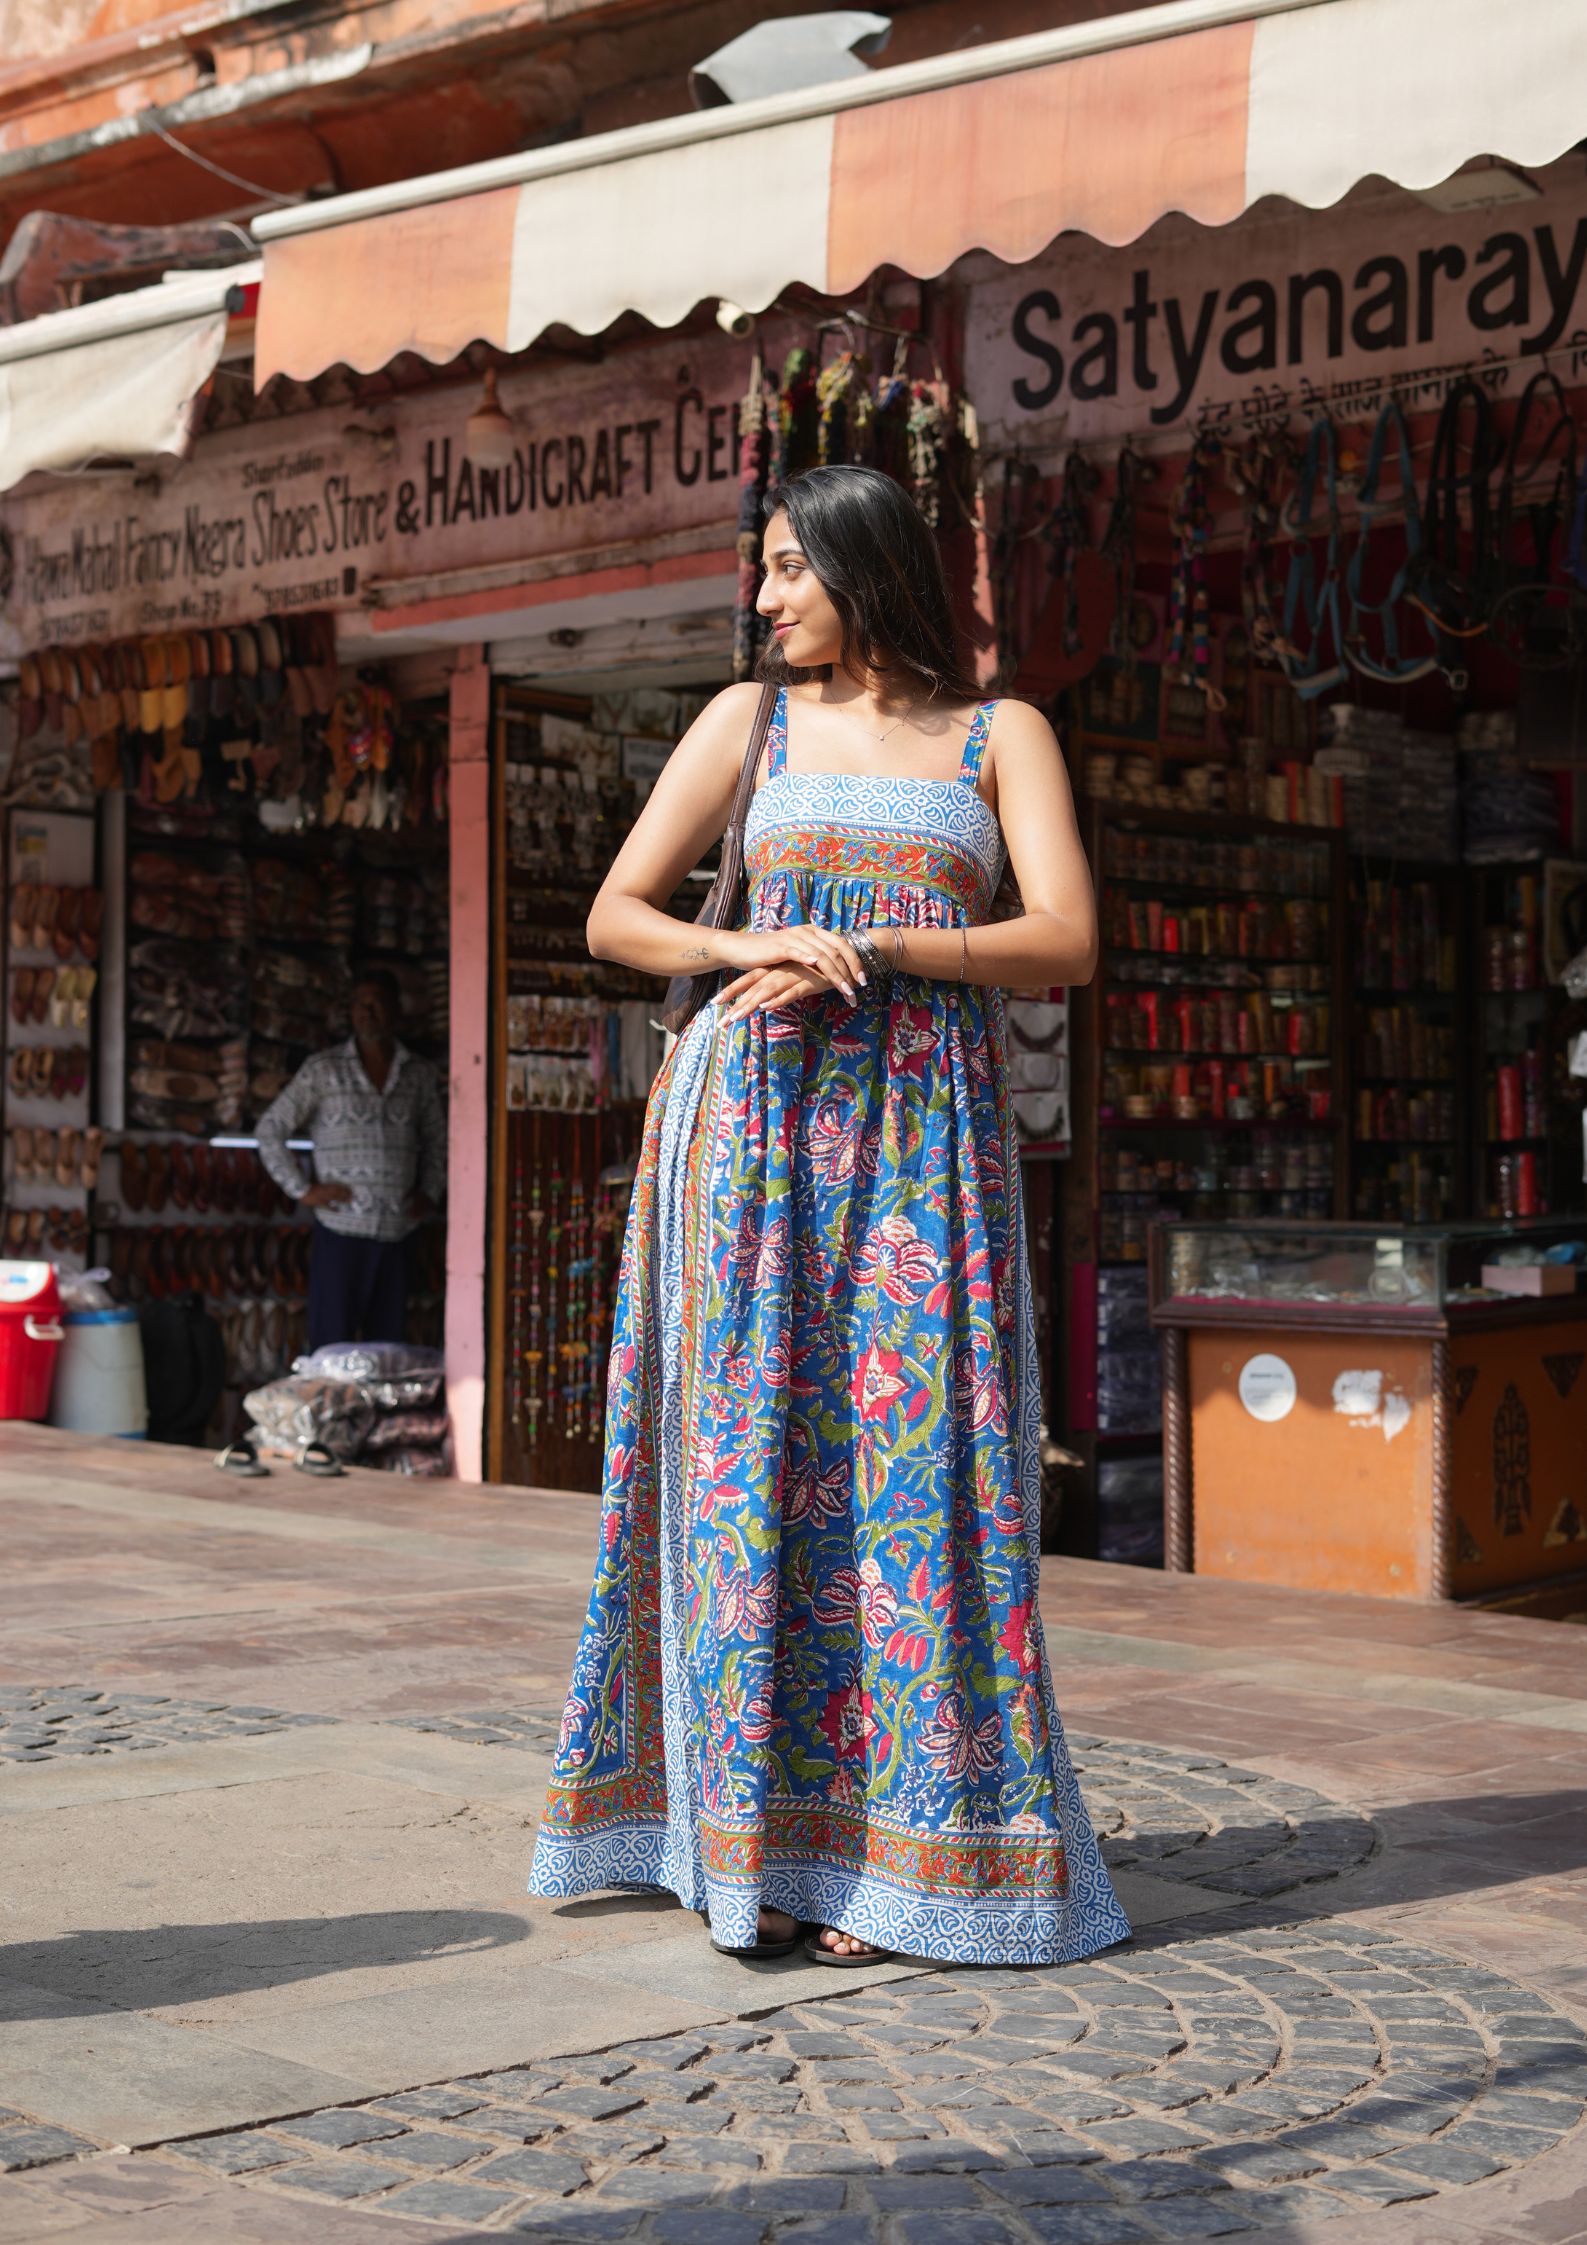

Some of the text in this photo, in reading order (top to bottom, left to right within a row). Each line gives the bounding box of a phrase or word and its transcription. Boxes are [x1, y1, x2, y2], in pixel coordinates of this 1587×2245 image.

[1011, 217, 1587, 425] Satyanaray
[251, 489, 319, 567] Shoes
[323, 475, 389, 554] Store
[395, 479, 420, 535] &
[424, 418, 662, 528] HANDICRAFT
